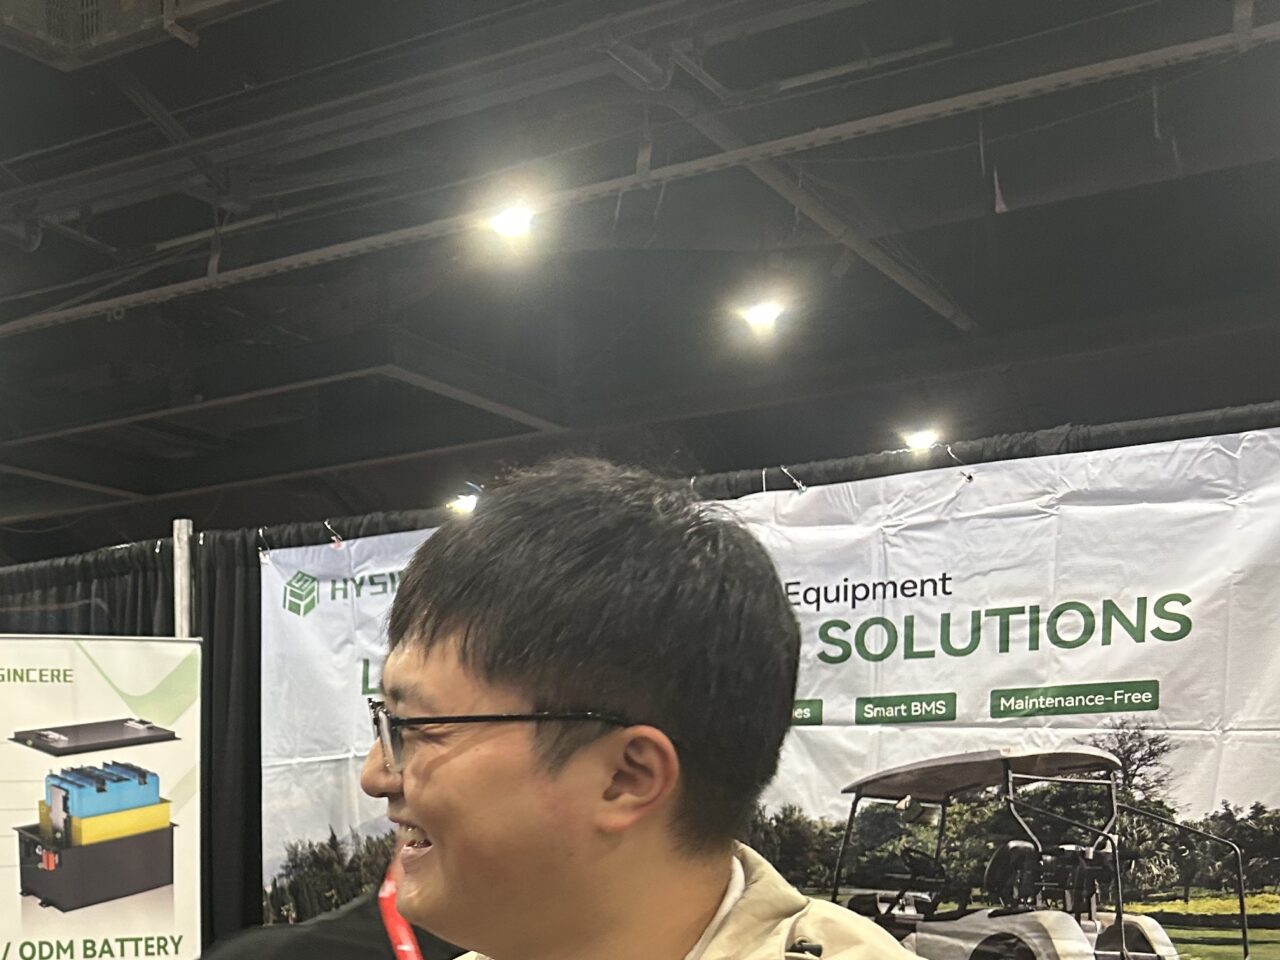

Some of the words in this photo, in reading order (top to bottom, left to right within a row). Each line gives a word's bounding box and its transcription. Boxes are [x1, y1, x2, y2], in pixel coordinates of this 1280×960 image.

[331, 570, 402, 601] HYSI
[785, 572, 953, 612] Equipment
[817, 593, 1193, 664] SOLUTIONS
[863, 703, 907, 718] Smart
[911, 700, 946, 716] BMS
[1000, 690, 1153, 711] Maintenance-Free
[82, 935, 184, 960] BATTERY
